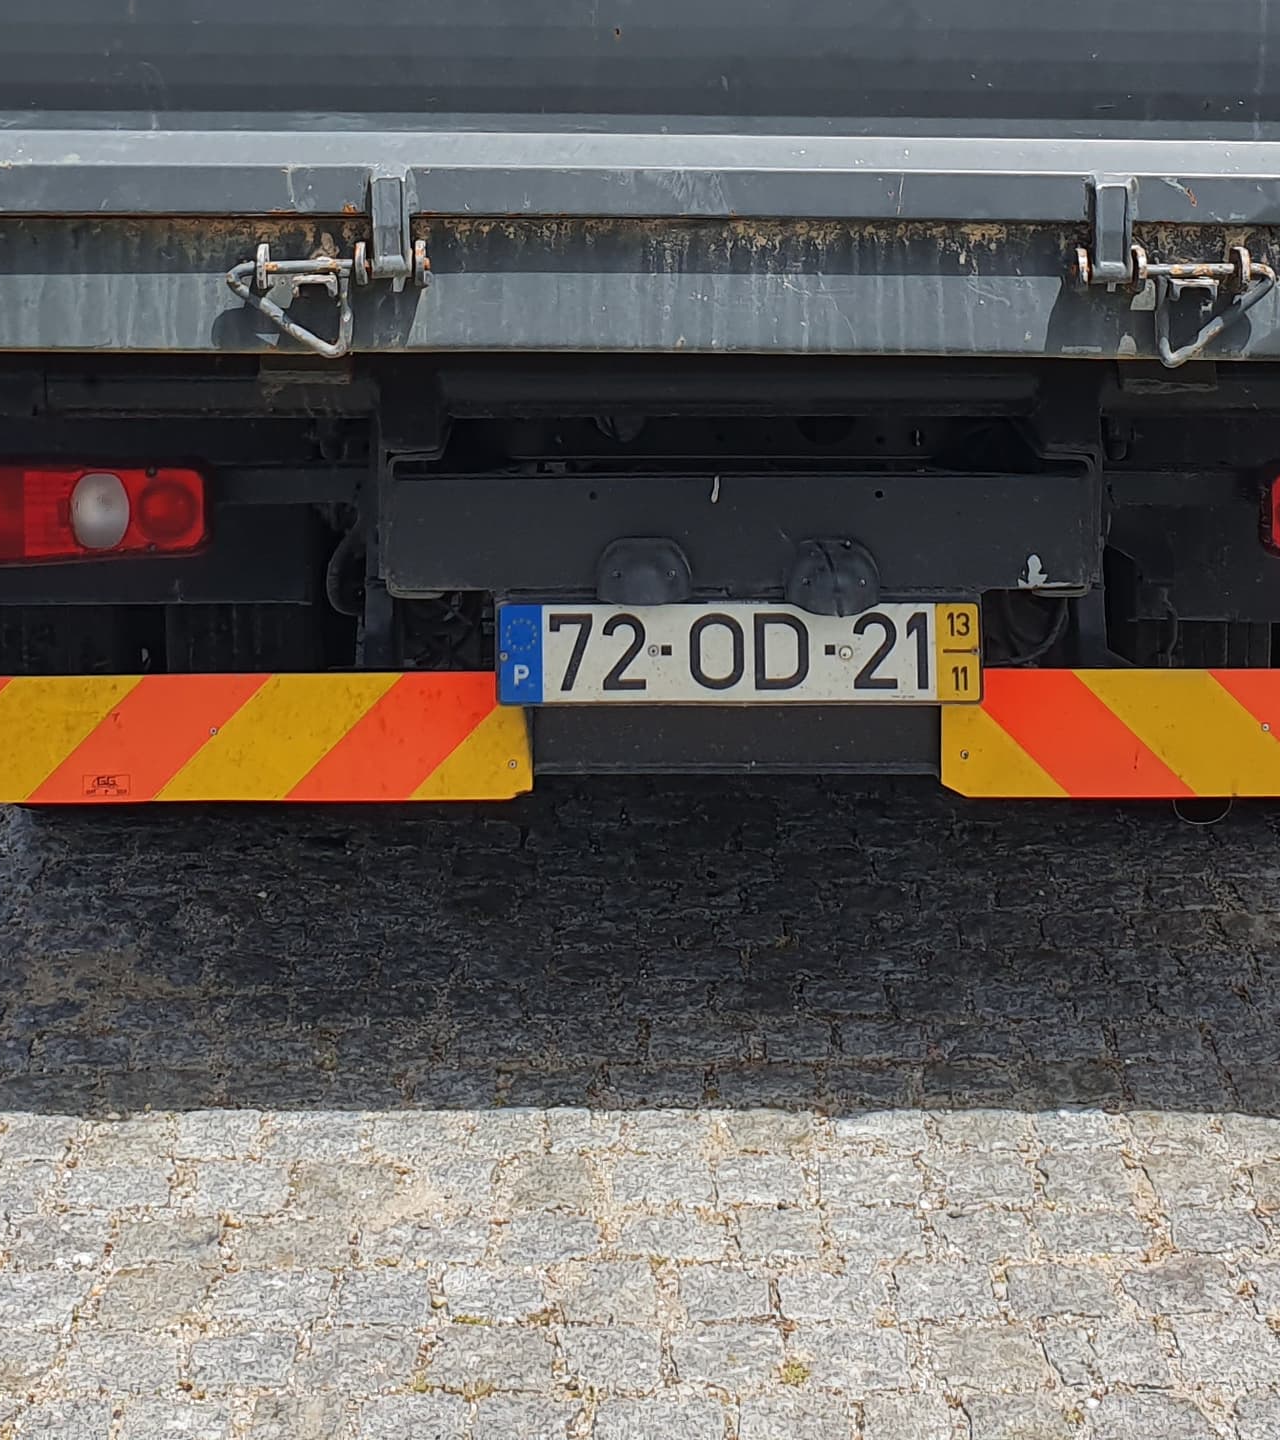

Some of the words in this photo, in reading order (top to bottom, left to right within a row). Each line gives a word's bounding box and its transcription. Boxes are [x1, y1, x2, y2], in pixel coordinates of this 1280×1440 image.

[947, 612, 970, 637] 13
[513, 665, 530, 687] P
[951, 665, 969, 691] 11
